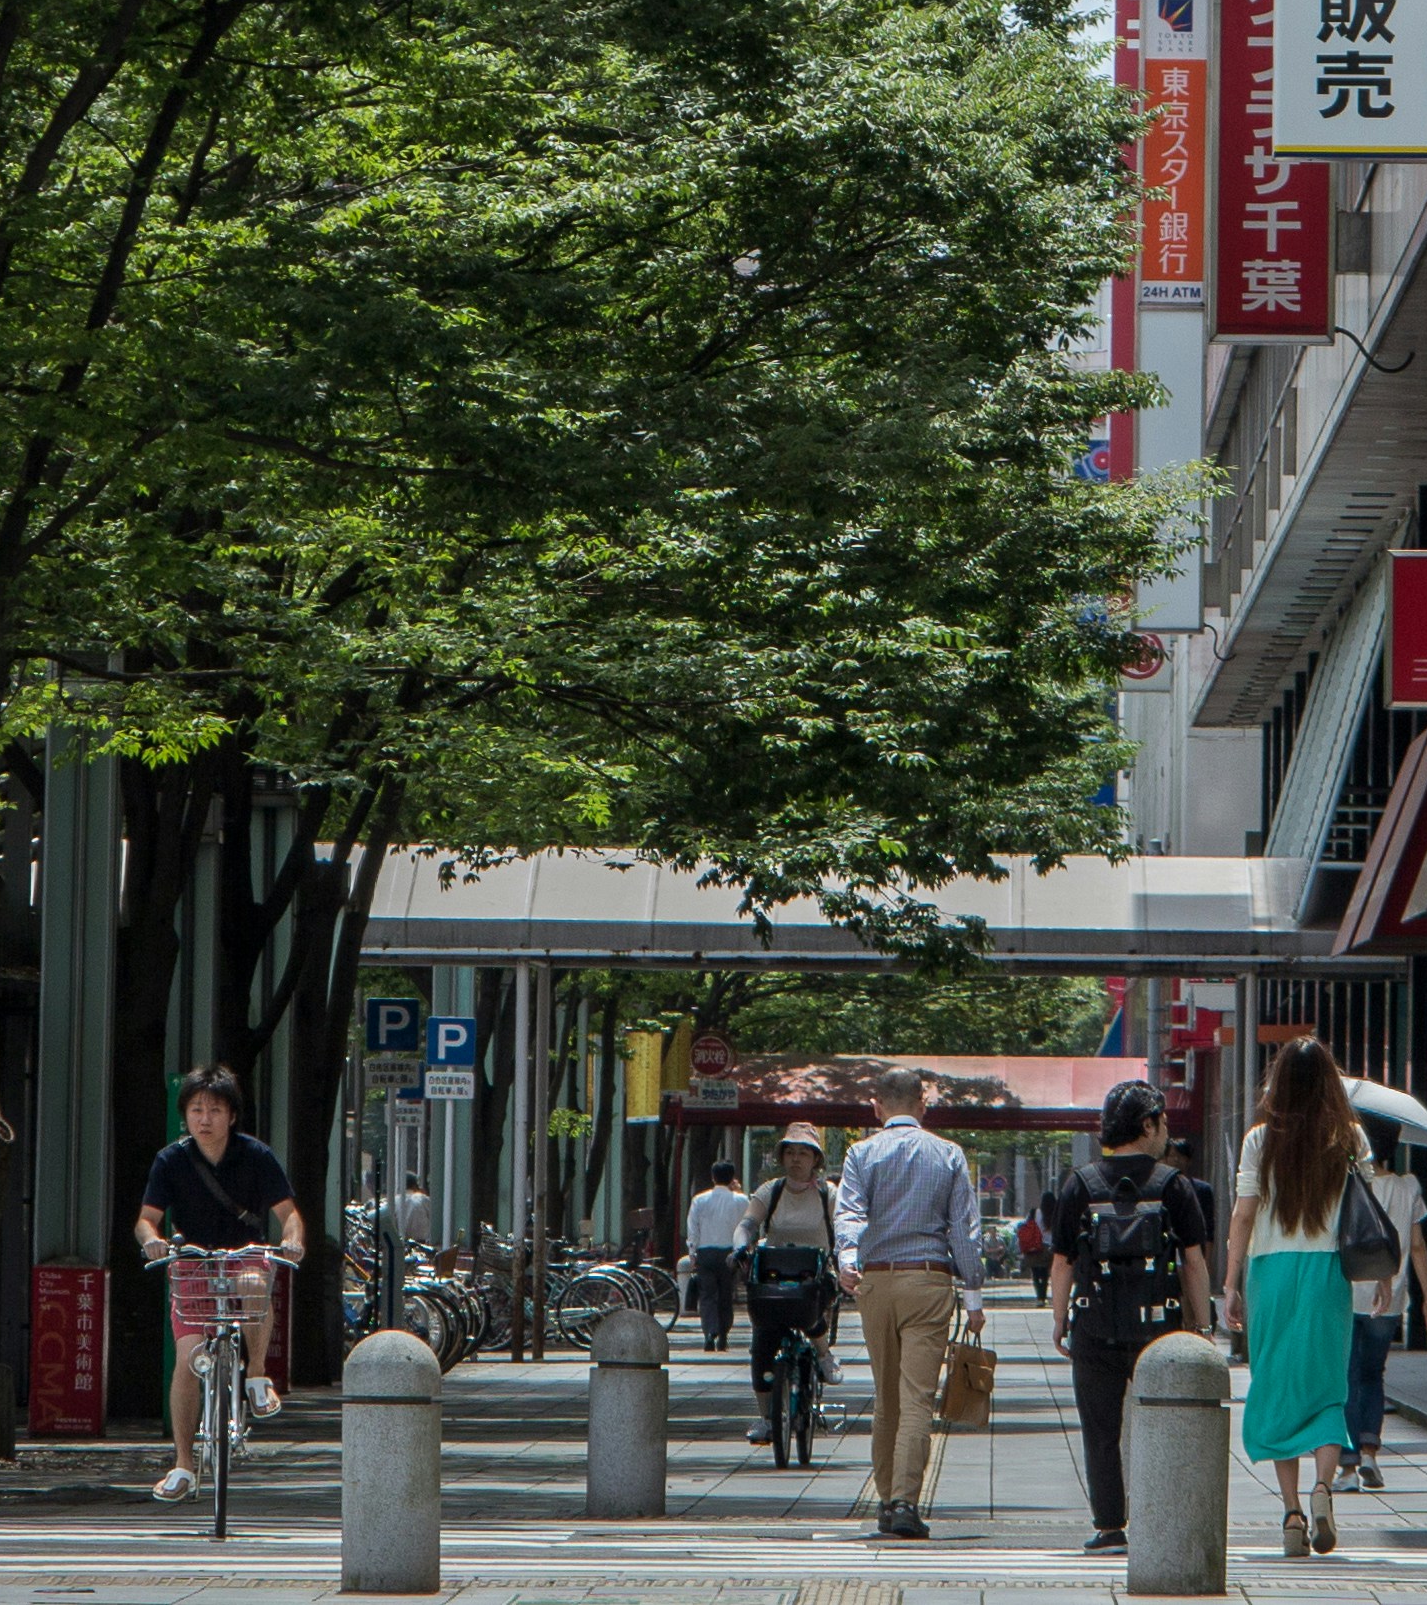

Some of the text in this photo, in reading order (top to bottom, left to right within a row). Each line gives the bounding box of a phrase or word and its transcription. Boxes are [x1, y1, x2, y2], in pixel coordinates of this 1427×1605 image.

[1157, 67, 1190, 275] 東京スター銀行
[1143, 285, 1202, 300] 24H ATM
[378, 1005, 411, 1045] P
[437, 1023, 468, 1061] P
